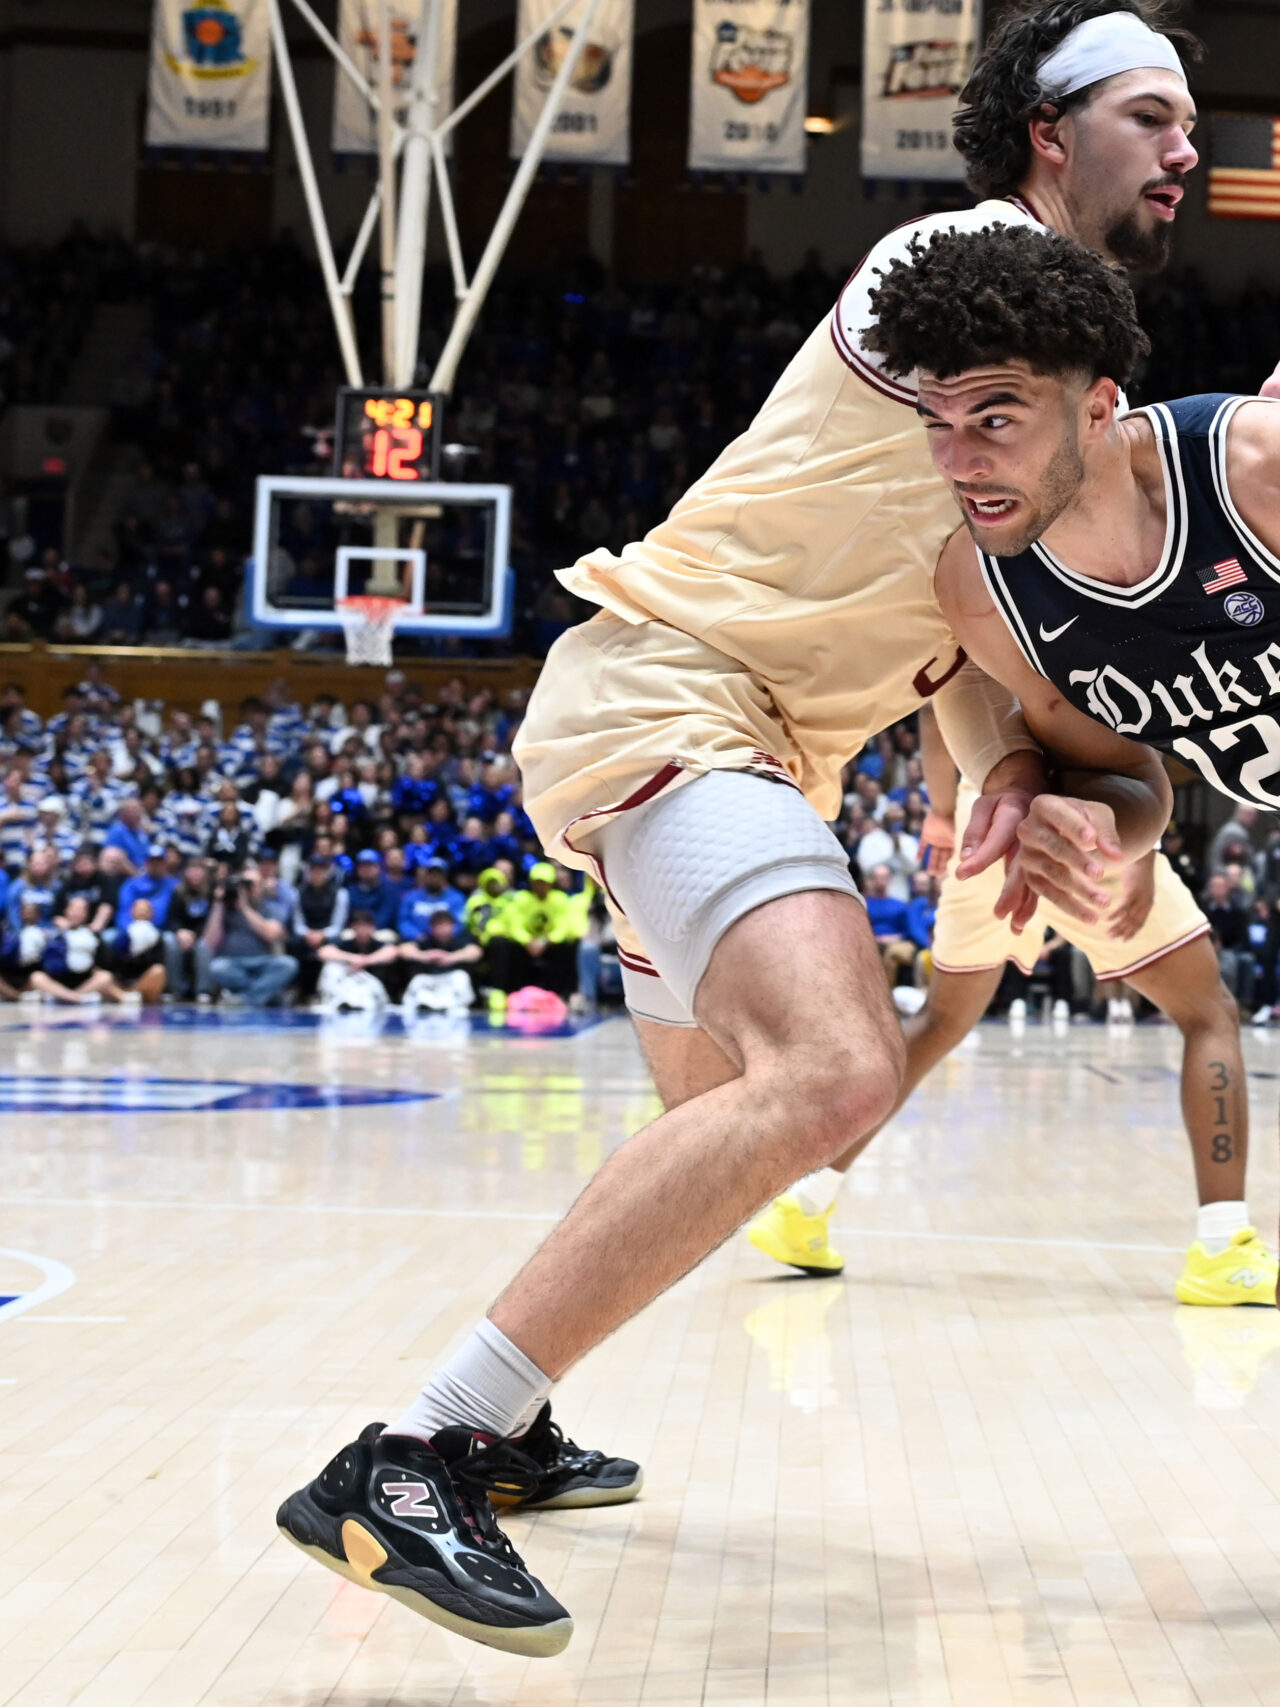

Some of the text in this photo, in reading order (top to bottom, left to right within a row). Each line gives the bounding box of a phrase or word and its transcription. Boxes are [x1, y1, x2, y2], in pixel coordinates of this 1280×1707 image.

[365, 398, 433, 429] 4:21
[372, 429, 423, 480] 12
[1208, 1061, 1232, 1164] 318
[381, 1481, 439, 1518] N
